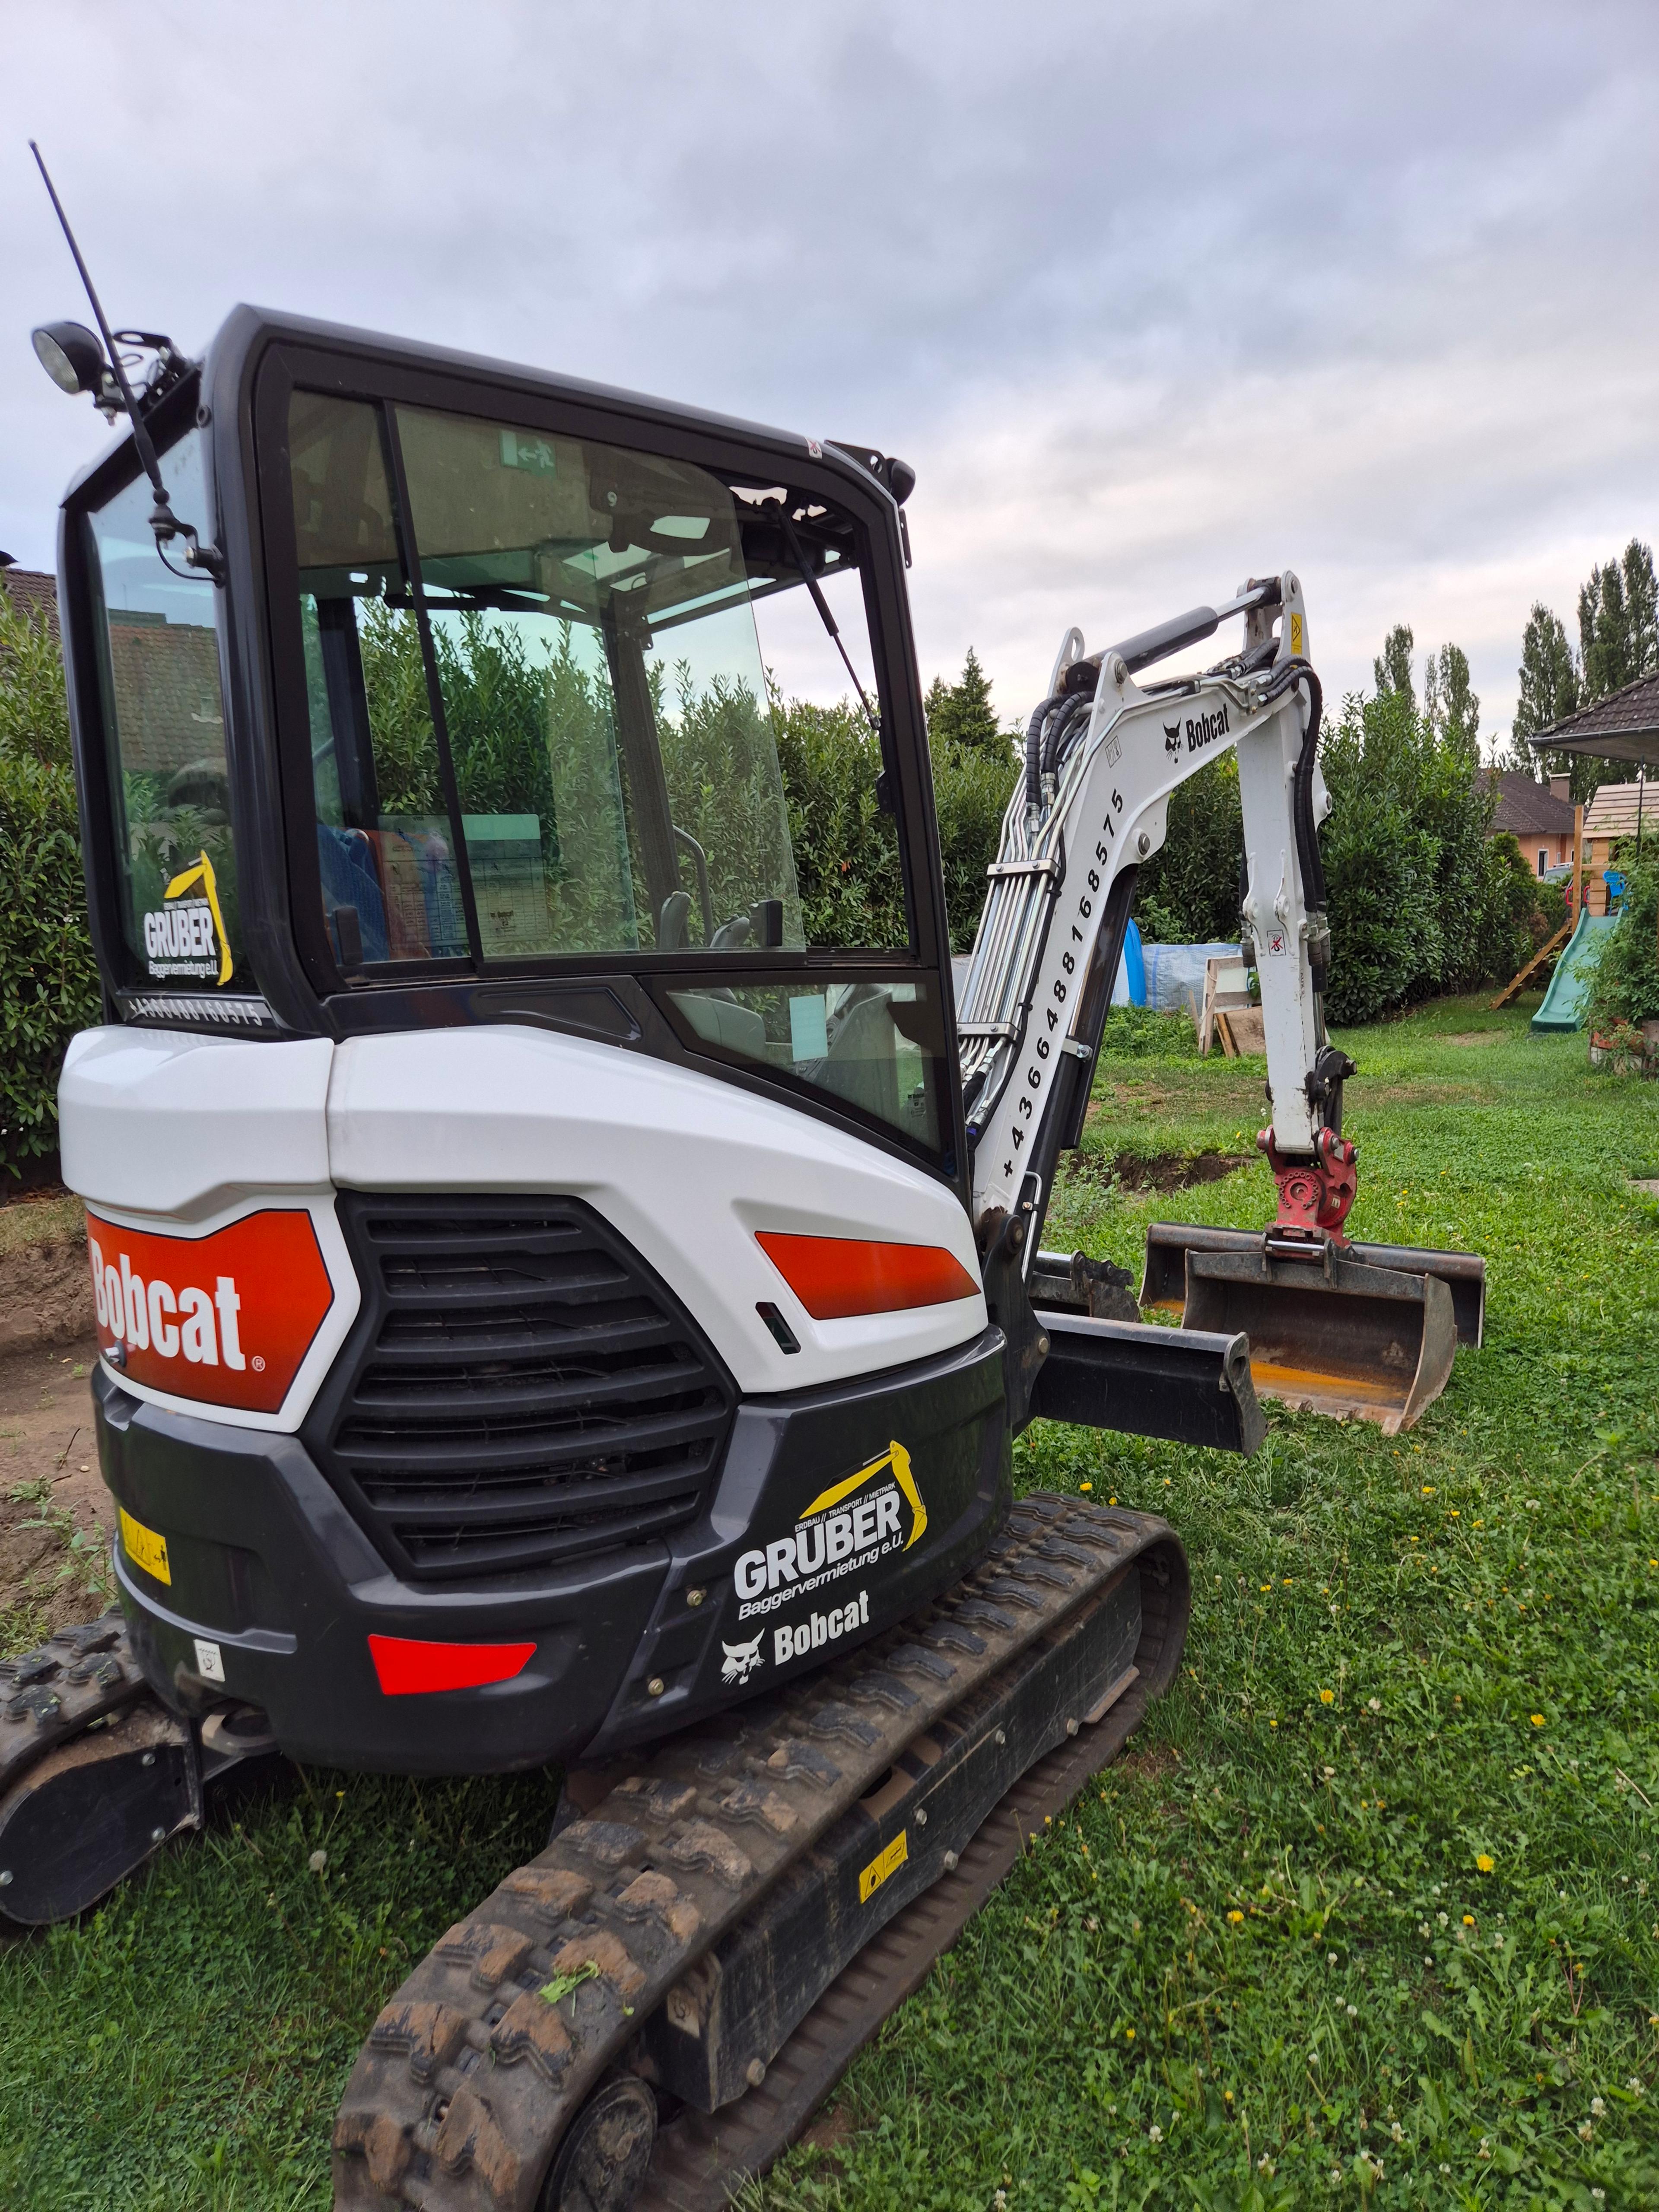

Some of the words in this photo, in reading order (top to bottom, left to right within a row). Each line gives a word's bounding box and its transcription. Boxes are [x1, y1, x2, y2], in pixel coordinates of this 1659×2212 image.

[1185, 703, 1230, 753] Bobcat
[144, 907, 216, 958] GRUBER
[89, 1236, 246, 1371] Bobcat
[734, 1490, 902, 1600] GRUBER
[794, 1515, 820, 1533] ERDBAU
[828, 1497, 863, 1519] TRANSPORT
[869, 1481, 896, 1501] MIETPARK
[738, 1547, 879, 1621] Baggervermietung
[881, 1531, 904, 1555] e.U.
[773, 1589, 870, 1666] Bobcat
